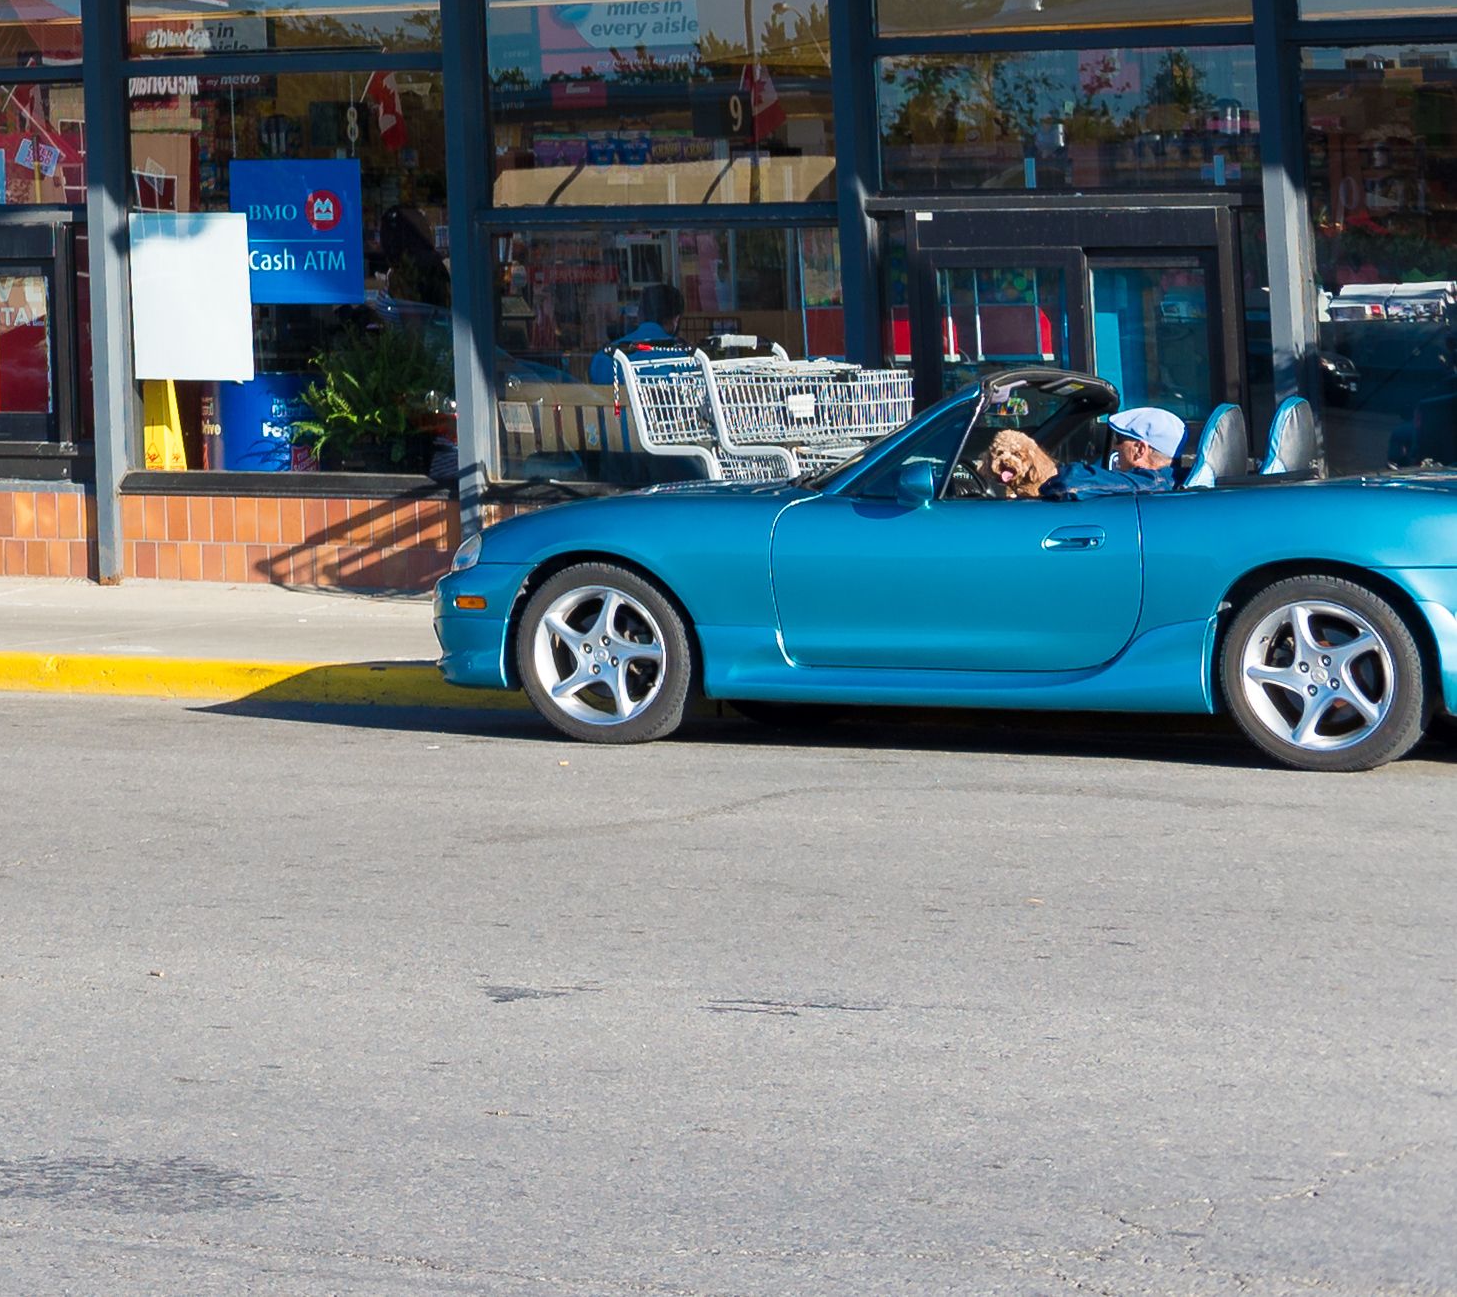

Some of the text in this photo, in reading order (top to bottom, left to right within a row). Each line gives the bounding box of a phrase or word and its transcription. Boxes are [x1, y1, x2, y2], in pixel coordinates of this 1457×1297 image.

[590, 16, 699, 39] every aisle
[729, 94, 742, 133] 9
[249, 204, 298, 221] BMO
[249, 248, 347, 272] Cash ATM
